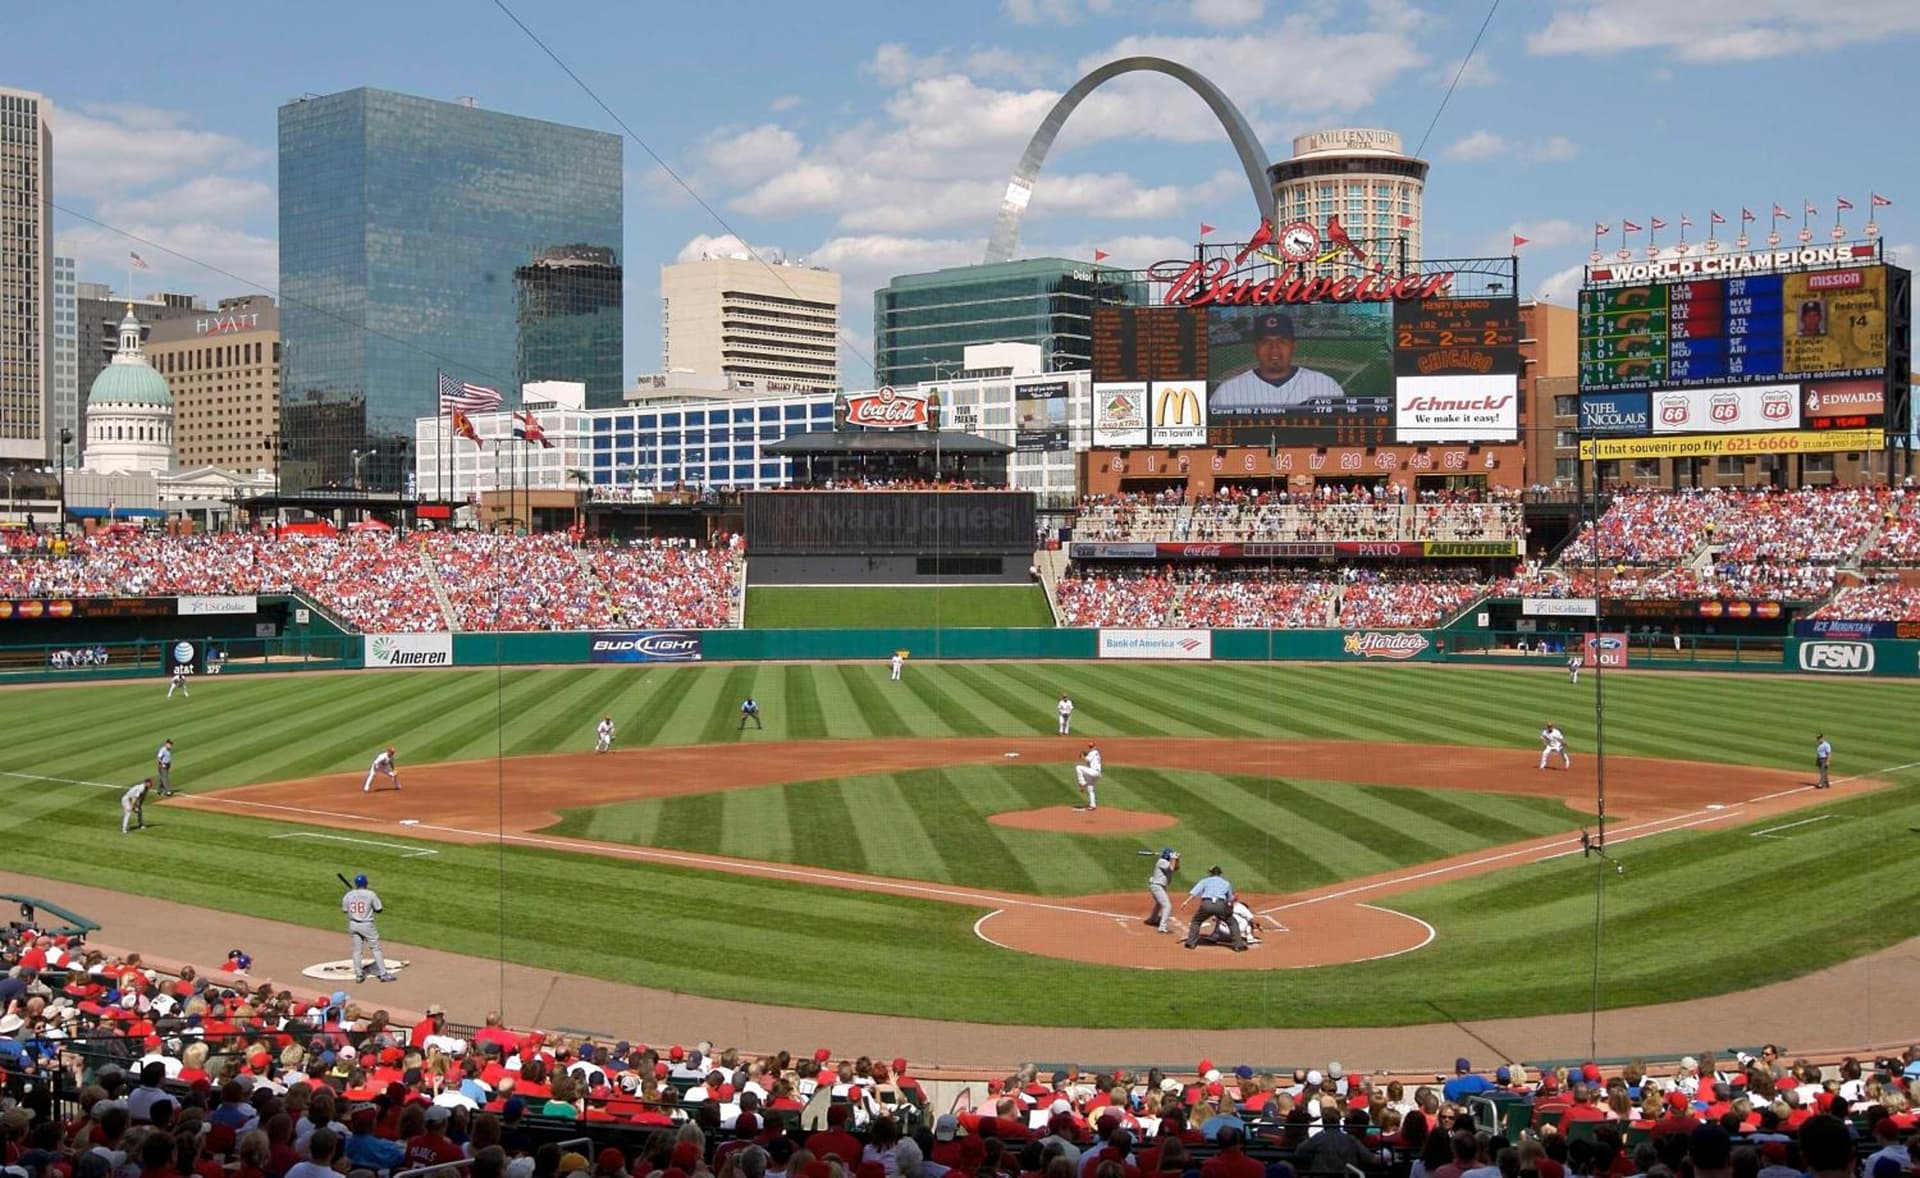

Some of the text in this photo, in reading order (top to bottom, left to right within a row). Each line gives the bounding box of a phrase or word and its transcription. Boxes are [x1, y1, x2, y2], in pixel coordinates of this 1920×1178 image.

[1319, 130, 1394, 145] MILLENNIUM
[1346, 141, 1373, 149] HOTEL
[1610, 262, 1695, 281] WORLD
[1701, 246, 1853, 273] CHAMPIONS
[1148, 256, 1454, 306] Budweiser
[1809, 273, 1860, 287] mission
[1422, 301, 1451, 311] HENRY
[196, 312, 259, 334] HYATT
[1729, 319, 1748, 327] ATL
[1849, 315, 1868, 328] 14
[1399, 330, 1498, 347] 2 2 2
[1417, 350, 1494, 374] CHICAGO
[1706, 376, 1723, 385] from
[1401, 395, 1513, 411] Schnucks
[1822, 392, 1884, 405] EDWARDS
[858, 399, 917, 421] Coca-Cola
[1374, 405, 1388, 413] 70
[1583, 402, 1618, 415] STIFEL
[1664, 408, 1685, 420] 66
[1714, 406, 1735, 418] 66
[1766, 403, 1787, 416] 66
[1416, 413, 1500, 423] We make it easy!
[1587, 413, 1646, 426] NICOLAUS
[1604, 443, 1627, 454] that
[1630, 441, 1678, 453] souvenir
[1680, 442, 1701, 454] pop
[1703, 440, 1723, 452] fly!
[1727, 435, 1800, 451] 621-6666
[1148, 456, 1154, 471] 1
[1211, 455, 1223, 470] 6
[1244, 455, 1255, 470] 9
[1275, 454, 1292, 470] 14
[1310, 454, 1325, 470] 17
[1341, 453, 1362, 469] 20
[1375, 453, 1397, 469] 42
[1410, 452, 1431, 468] 45
[1443, 452, 1465, 467] 85
[1359, 543, 1401, 556] PATIO
[1428, 543, 1512, 556] AUTOTIRE
[1813, 621, 1873, 632] ICE MOUNTAIN
[593, 640, 699, 651] BUD LIGHT
[1106, 639, 1175, 648] Bank of America
[390, 650, 447, 665] Ameren
[1810, 644, 1863, 668] FSN
[350, 902, 365, 914] 38
